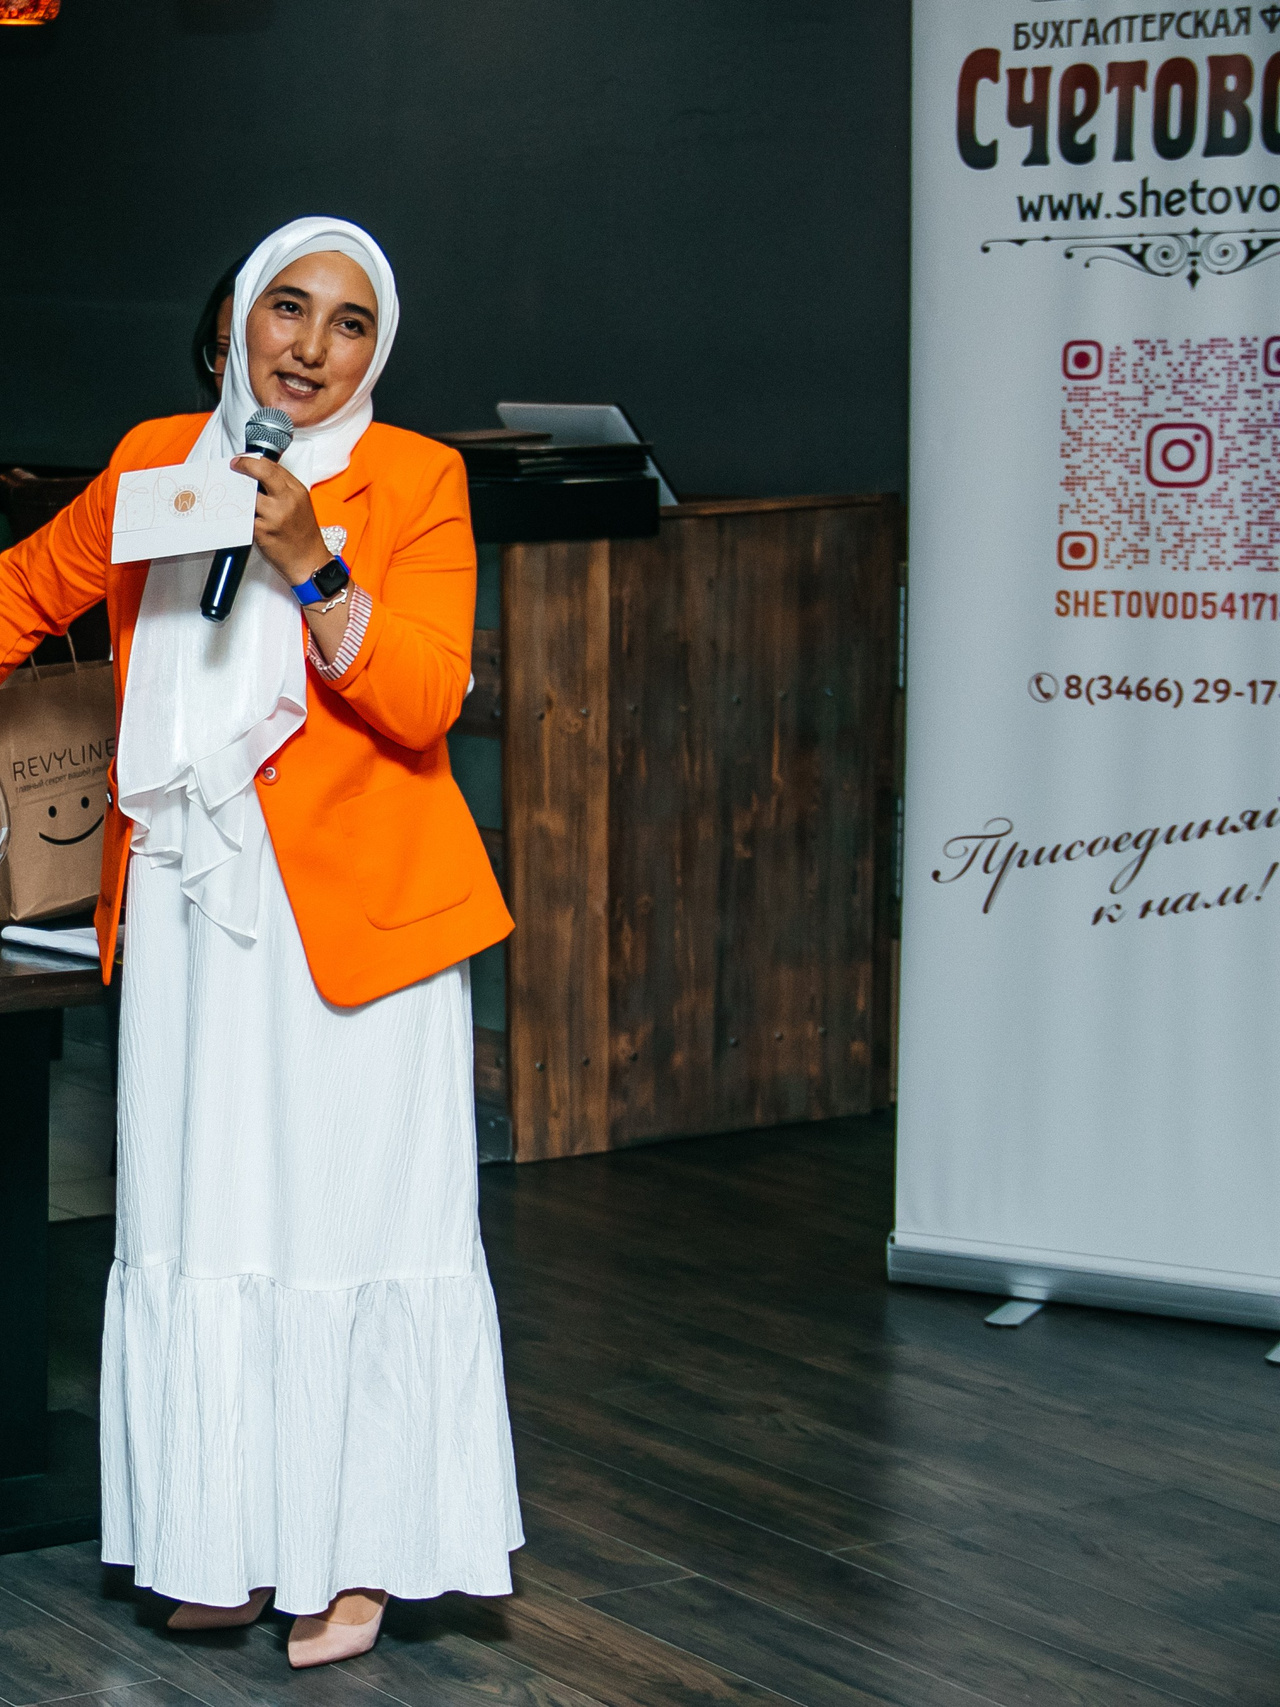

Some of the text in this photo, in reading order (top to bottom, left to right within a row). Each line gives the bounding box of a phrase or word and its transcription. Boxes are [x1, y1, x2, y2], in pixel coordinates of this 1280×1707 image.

[1013, 6, 1251, 50] БУХГАЛТЕРСКАЯ
[1017, 177, 1280, 223] www.shetovo
[1064, 675, 1280, 708] 8(3466) 29-17
[13, 737, 115, 782] REVYLINE
[1091, 861, 1280, 926] к нам!
